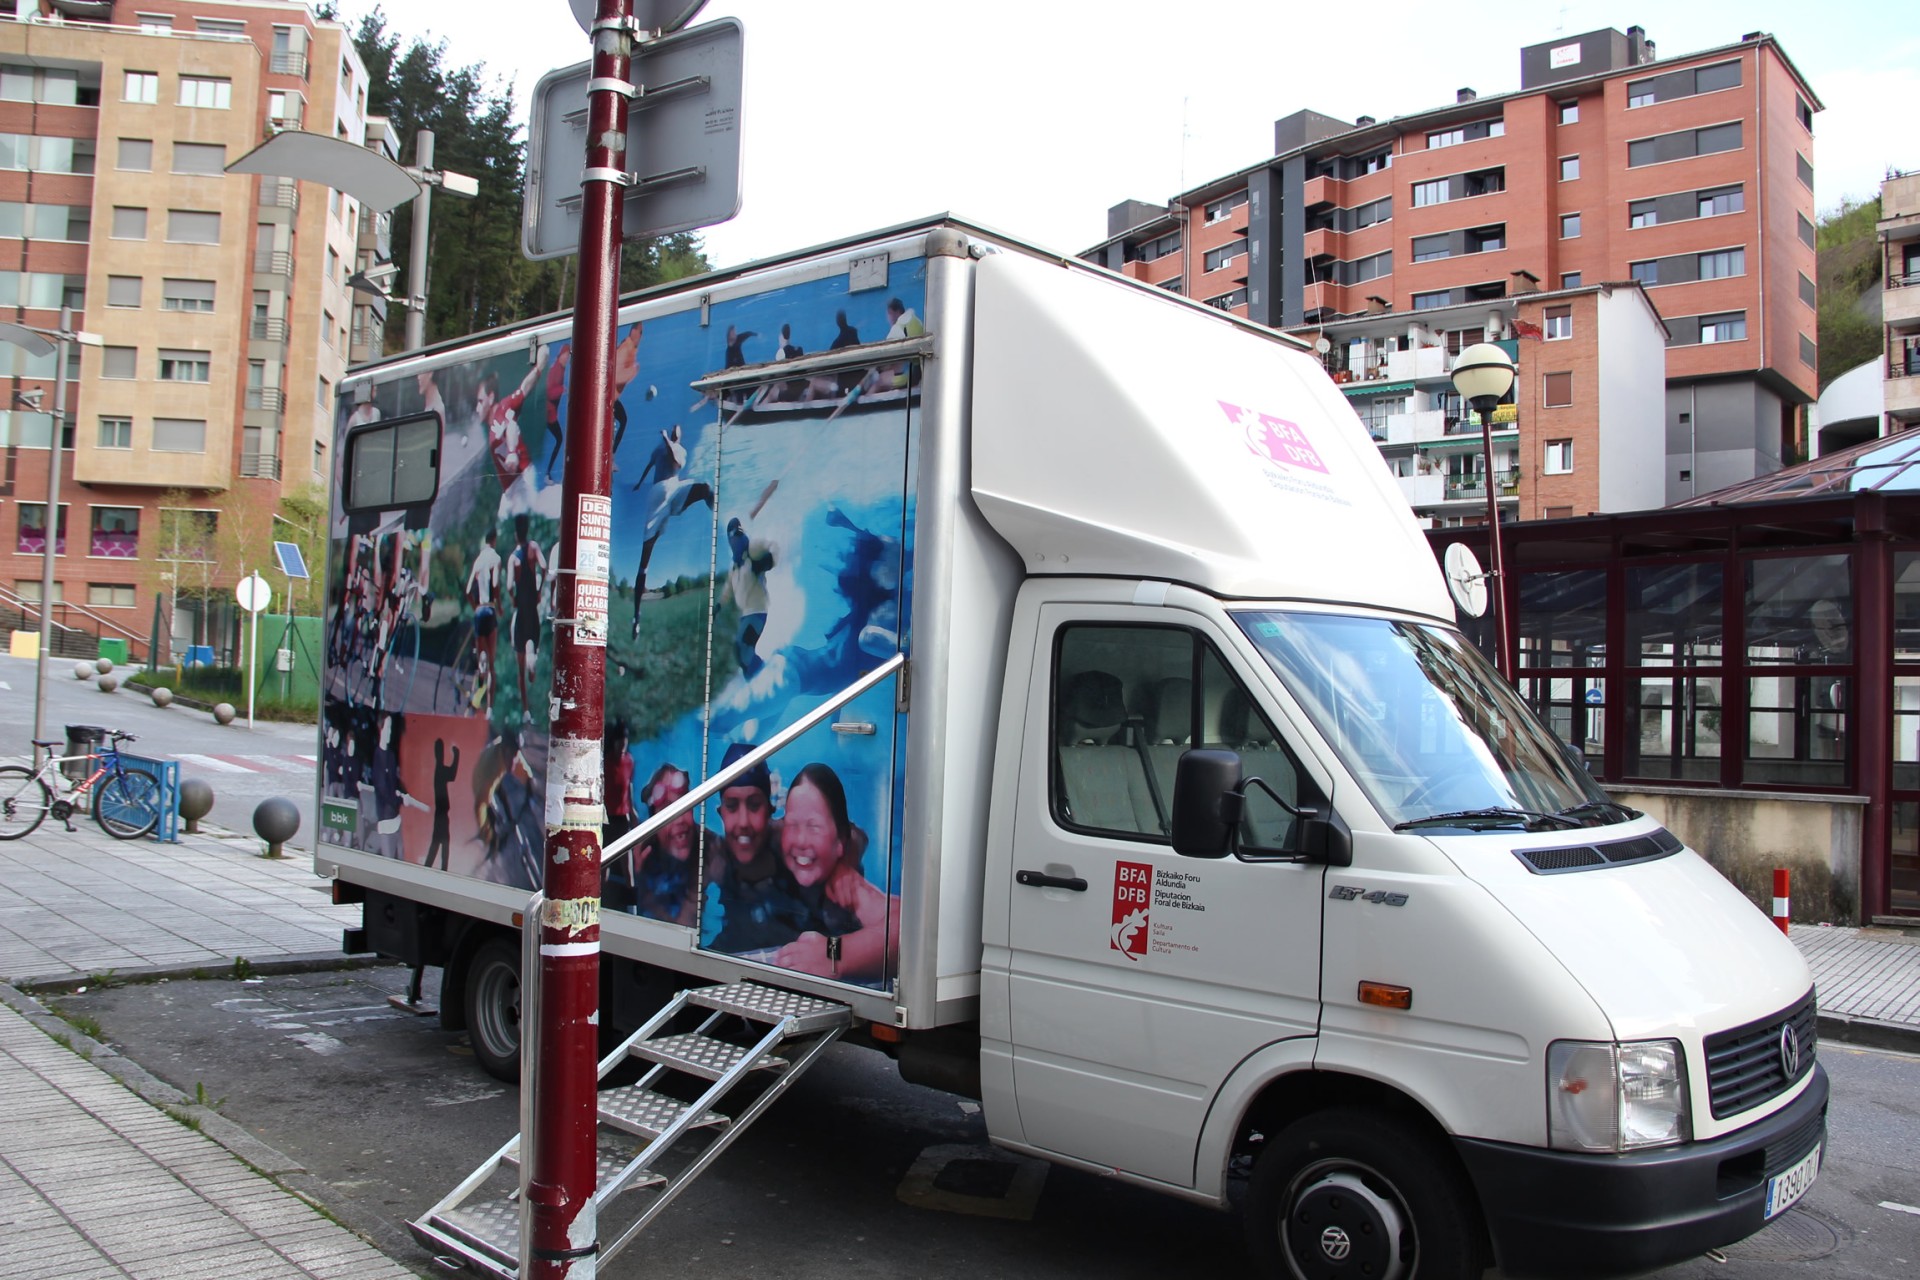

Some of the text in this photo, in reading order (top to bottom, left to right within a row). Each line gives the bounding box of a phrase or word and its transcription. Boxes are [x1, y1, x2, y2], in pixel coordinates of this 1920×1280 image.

[1266, 420, 1307, 445] BFA
[1281, 443, 1321, 467] DFB
[580, 552, 595, 567] 29
[331, 811, 348, 825] bbk
[1119, 866, 1147, 884] BFA
[1156, 869, 1201, 883] Bizkaiko Foru
[1156, 878, 1186, 889] Aldundia
[1118, 886, 1146, 904] DFB
[1328, 885, 1366, 901] LT
[1154, 898, 1206, 912] Foral de Bizkaia
[1153, 922, 1173, 931] Kultura
[1152, 939, 1191, 951] Departamento
[1152, 945, 1172, 955] Cultura
